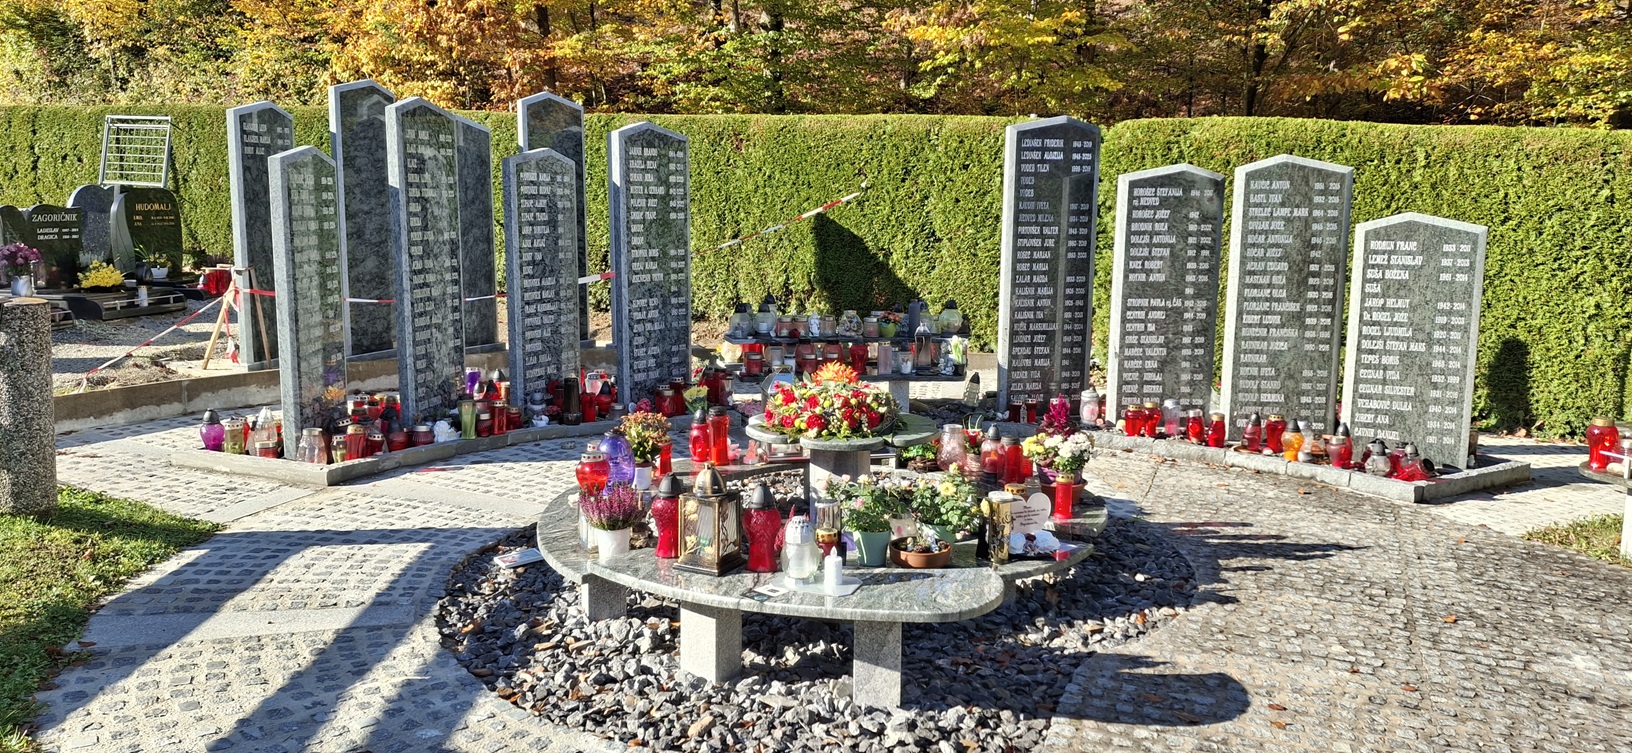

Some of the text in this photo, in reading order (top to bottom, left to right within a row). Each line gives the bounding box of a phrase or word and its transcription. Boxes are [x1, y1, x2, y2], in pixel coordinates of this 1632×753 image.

[1044, 139, 1064, 147] FRIDERIK
[1272, 181, 1290, 190] ANTON
[1157, 188, 1183, 196] ŠTEFANIJA
[1269, 194, 1282, 202] IVAN
[135, 203, 171, 211] HUDOMALJ
[1249, 208, 1272, 216] STRELEC
[1273, 208, 1291, 216] LAMPE
[1293, 208, 1308, 216] MARK
[32, 212, 77, 222] ZAGORIČNIK
[1152, 235, 1176, 244] ANTONIJA
[1396, 242, 1417, 251] FRANC
[1151, 248, 1170, 256] ŠTEFAN
[1390, 255, 1423, 265] STANISLAV
[1367, 269, 1382, 279] SUŠA
[1385, 269, 1409, 279] BOŽENA
[1365, 284, 1381, 293] SUŠA
[1244, 289, 1286, 298] FLORJANC OLGA
[1244, 302, 1270, 311] FLORJANC
[1386, 299, 1410, 308] HELMUT
[1148, 311, 1166, 319] ANDREJ
[1393, 312, 1408, 322] JOŽE
[1384, 327, 1412, 336] LJUDMILA
[1386, 340, 1407, 350] ŠTEFAN
[1145, 348, 1167, 356] VALENTIN
[1381, 356, 1399, 365] BORIS
[1386, 371, 1400, 380] VIDA
[1385, 385, 1414, 395] SILVESTER
[1376, 415, 1389, 424] ANA
